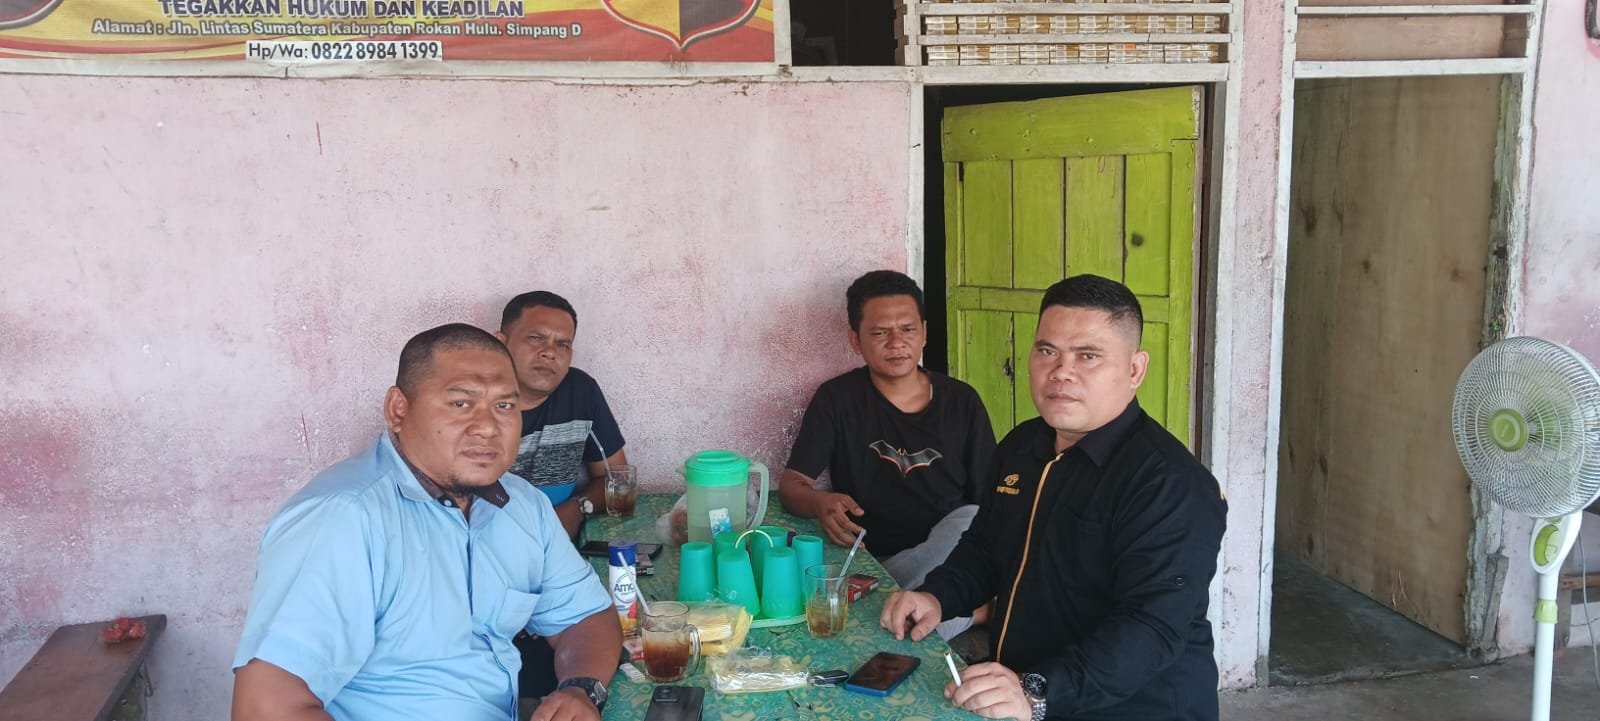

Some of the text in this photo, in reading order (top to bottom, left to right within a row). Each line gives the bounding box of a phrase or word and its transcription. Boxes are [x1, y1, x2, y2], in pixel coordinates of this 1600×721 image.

[159, 0, 524, 17] TEGAKKAN HUKUM DAN KEADILAN
[93, 19, 153, 34] Alamat
[167, 21, 198, 35] Jln.
[200, 21, 250, 35] Lintas
[253, 21, 327, 36] Sumatera
[331, 22, 412, 37] Kabupaten
[415, 22, 461, 35] Rokan
[465, 22, 502, 35] Hulu.
[506, 23, 567, 38] Simpang
[571, 24, 582, 36] D
[248, 42, 438, 59] Hp/Wa: 0822 8984 1399
